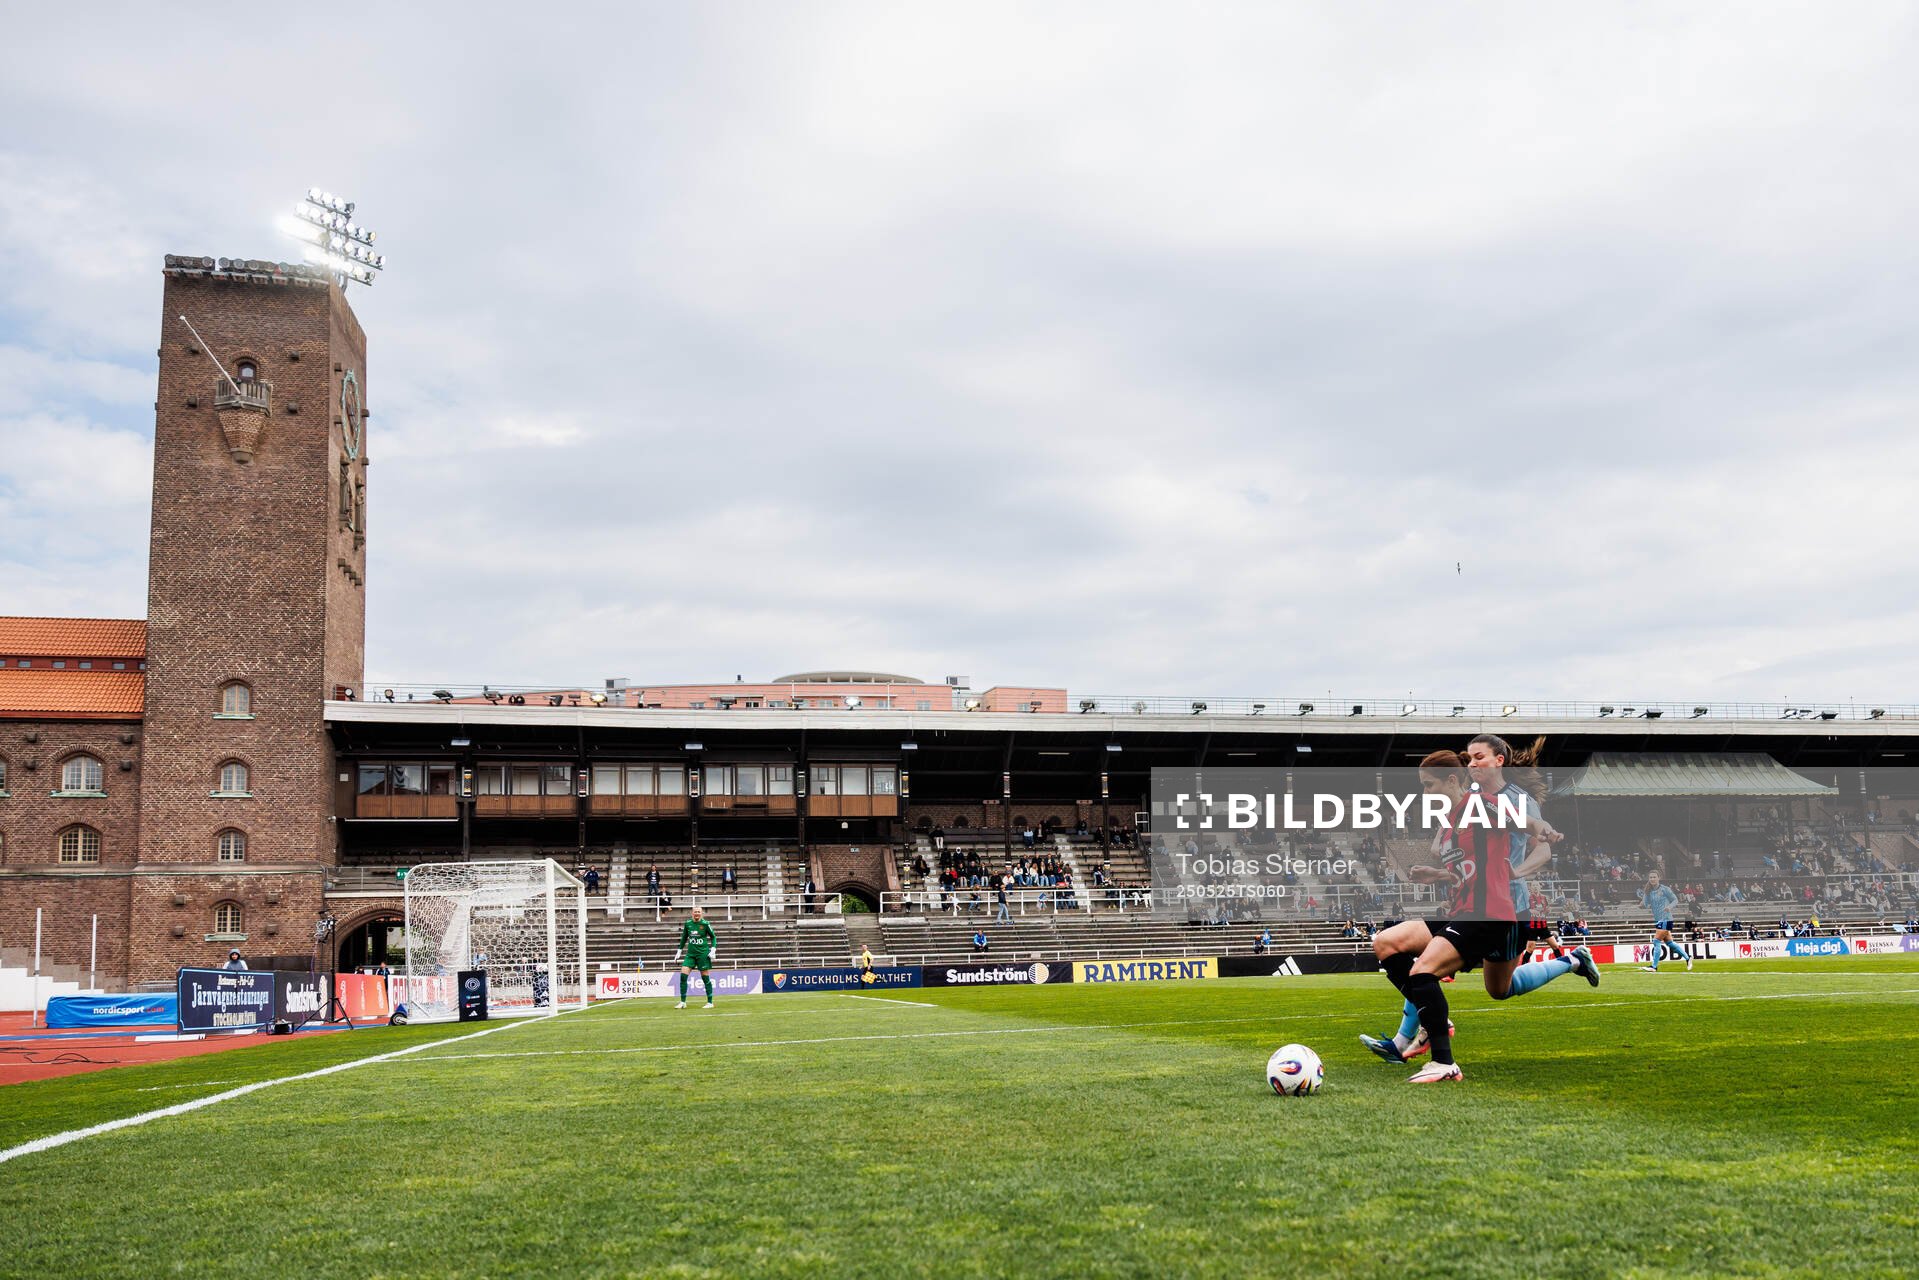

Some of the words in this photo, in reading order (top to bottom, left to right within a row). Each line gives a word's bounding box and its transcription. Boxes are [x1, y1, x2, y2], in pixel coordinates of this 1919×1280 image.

[1753, 944, 1780, 952] SVENSKA
[1795, 943, 1819, 954] Heja
[1820, 941, 1841, 954] dig!
[946, 967, 1028, 983] Sundström
[1084, 961, 1208, 983] RAMIRENT
[622, 979, 660, 987] SVENSKA
[719, 974, 747, 989] alla!
[790, 974, 858, 985] STOCKHOLMS
[622, 986, 641, 994] SPEL
